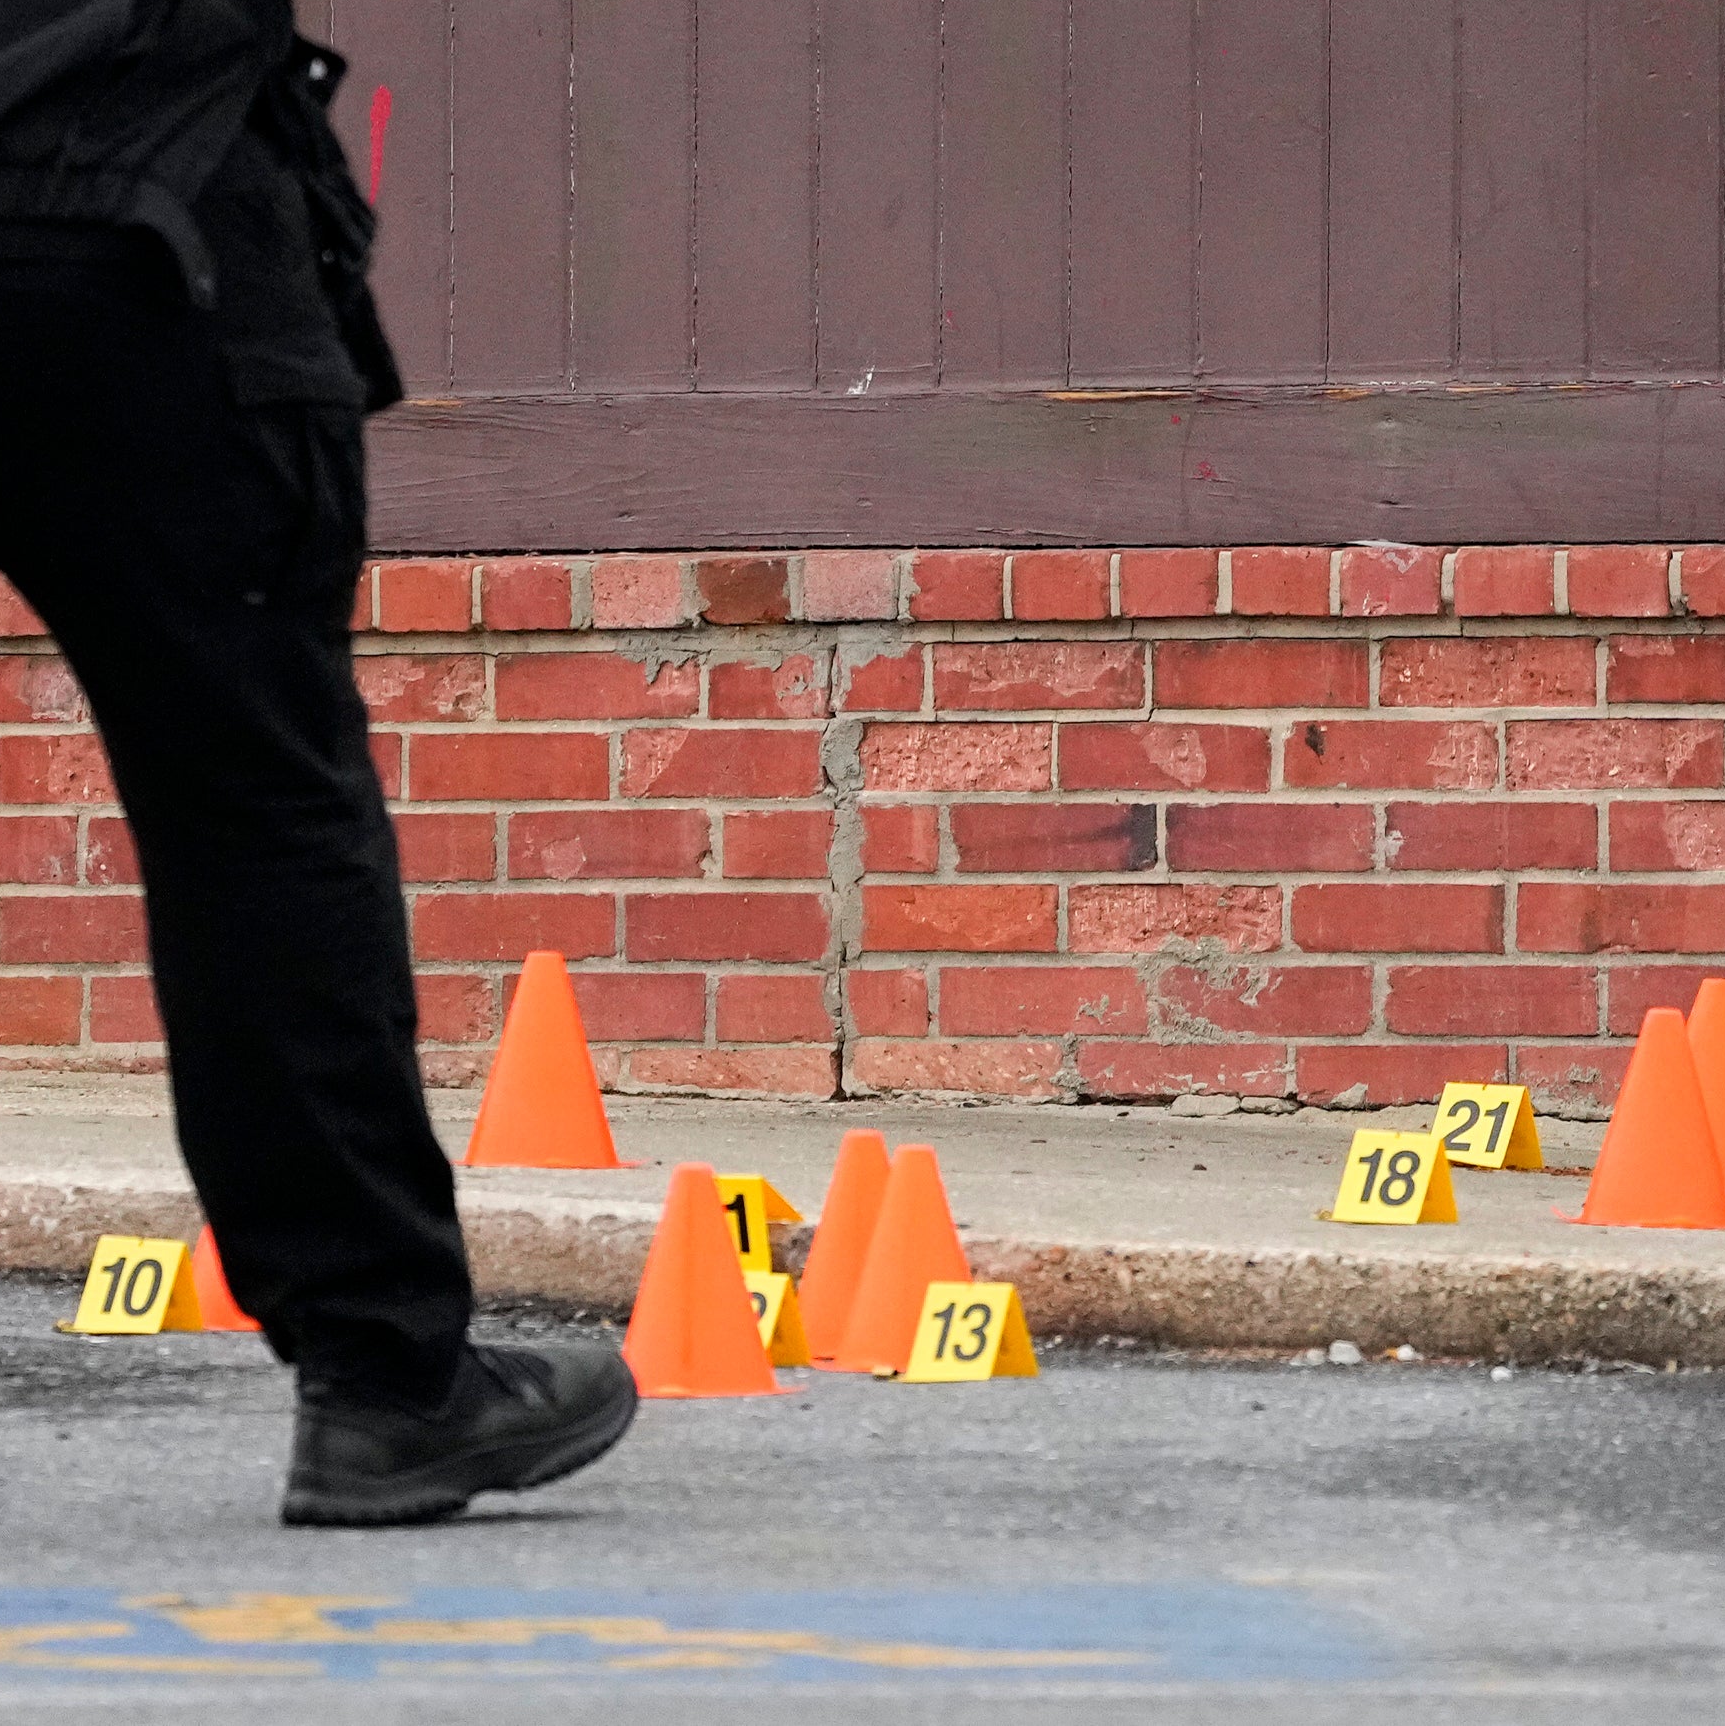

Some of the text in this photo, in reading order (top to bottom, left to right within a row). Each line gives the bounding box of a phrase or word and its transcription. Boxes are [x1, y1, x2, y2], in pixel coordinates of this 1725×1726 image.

[1444, 1099, 1510, 1153] 21
[1358, 1148, 1421, 1206] 18
[101, 1257, 163, 1316] 10
[932, 1302, 992, 1361] 13
